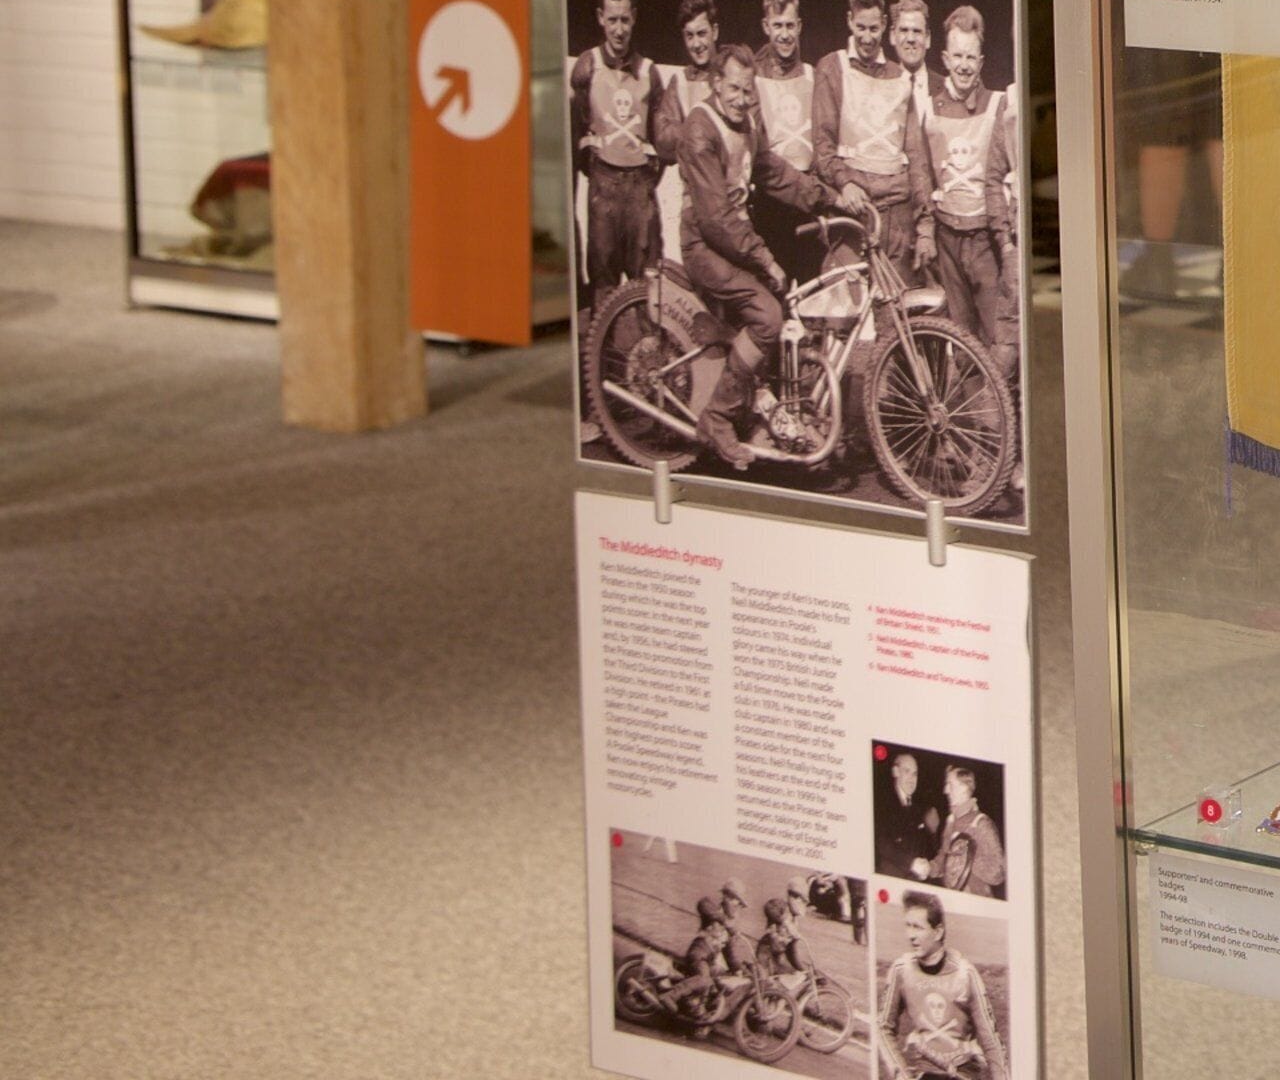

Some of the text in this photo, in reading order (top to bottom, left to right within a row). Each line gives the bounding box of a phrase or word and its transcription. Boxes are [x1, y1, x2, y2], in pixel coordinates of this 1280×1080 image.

[599, 536, 724, 571] The Middleditch dynasty
